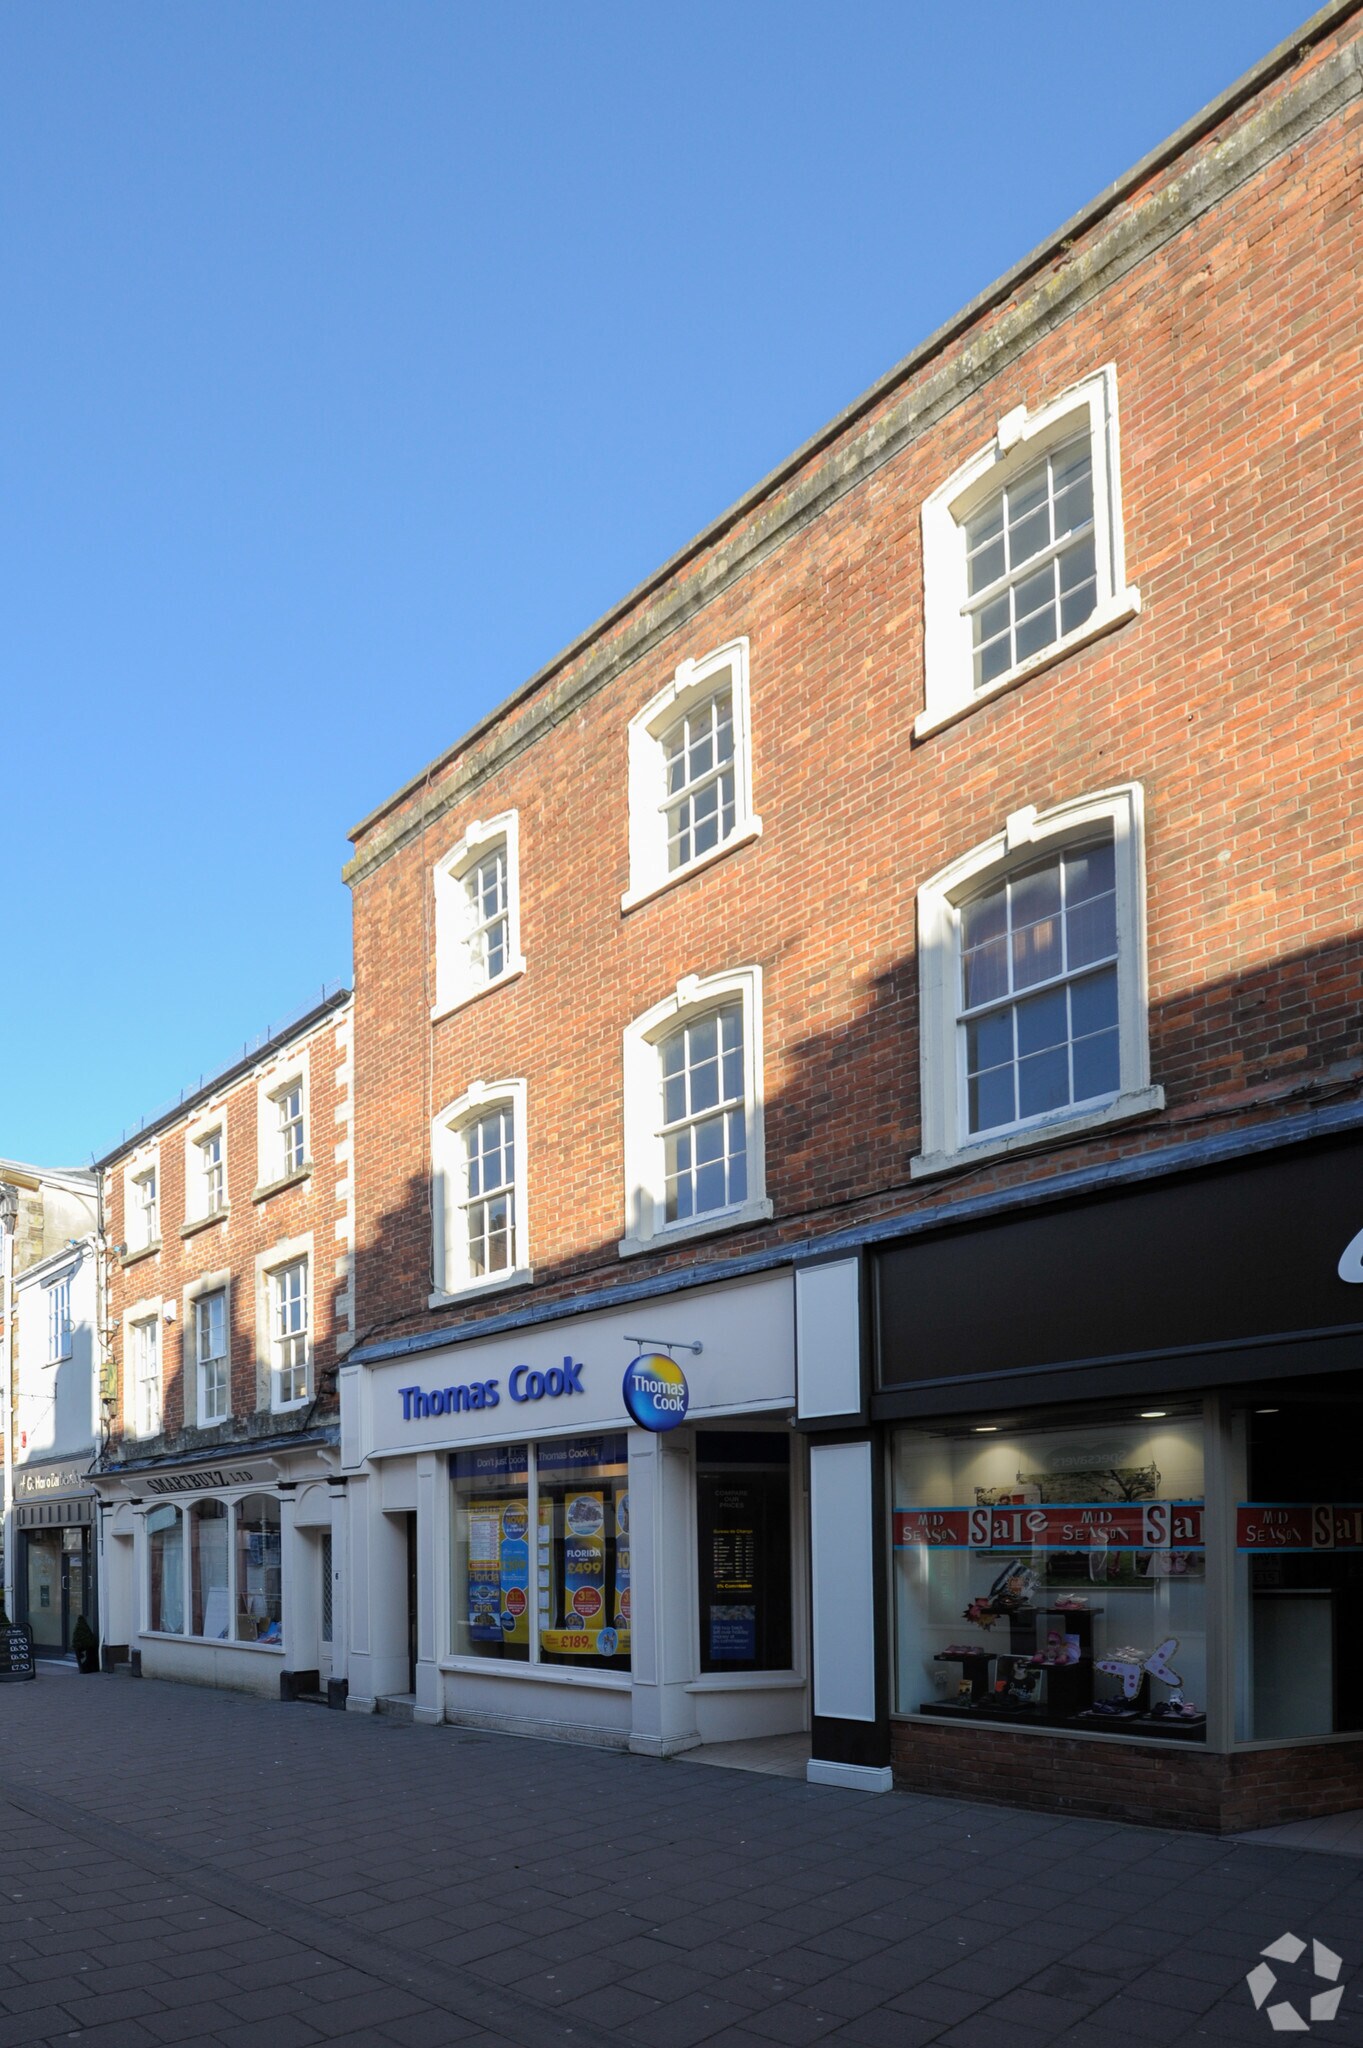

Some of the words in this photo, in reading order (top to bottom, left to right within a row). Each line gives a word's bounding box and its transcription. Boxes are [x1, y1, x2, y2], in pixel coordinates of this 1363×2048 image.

[398, 1378, 500, 1421] Thomas
[508, 1355, 585, 1403] Cook
[632, 1375, 685, 1397] Thomas
[653, 1396, 685, 1412] Cook
[476, 1456, 494, 1468] Don't
[495, 1456, 507, 1468] just
[568, 1448, 589, 1459] Cook
[146, 1471, 230, 1494] SMARTBUYZ
[229, 1471, 254, 1482] LTD
[917, 1512, 944, 1526] MID
[1081, 1510, 1113, 1524] MID
[1262, 1510, 1289, 1525] MID
[567, 1549, 602, 1558] FLORIDA
